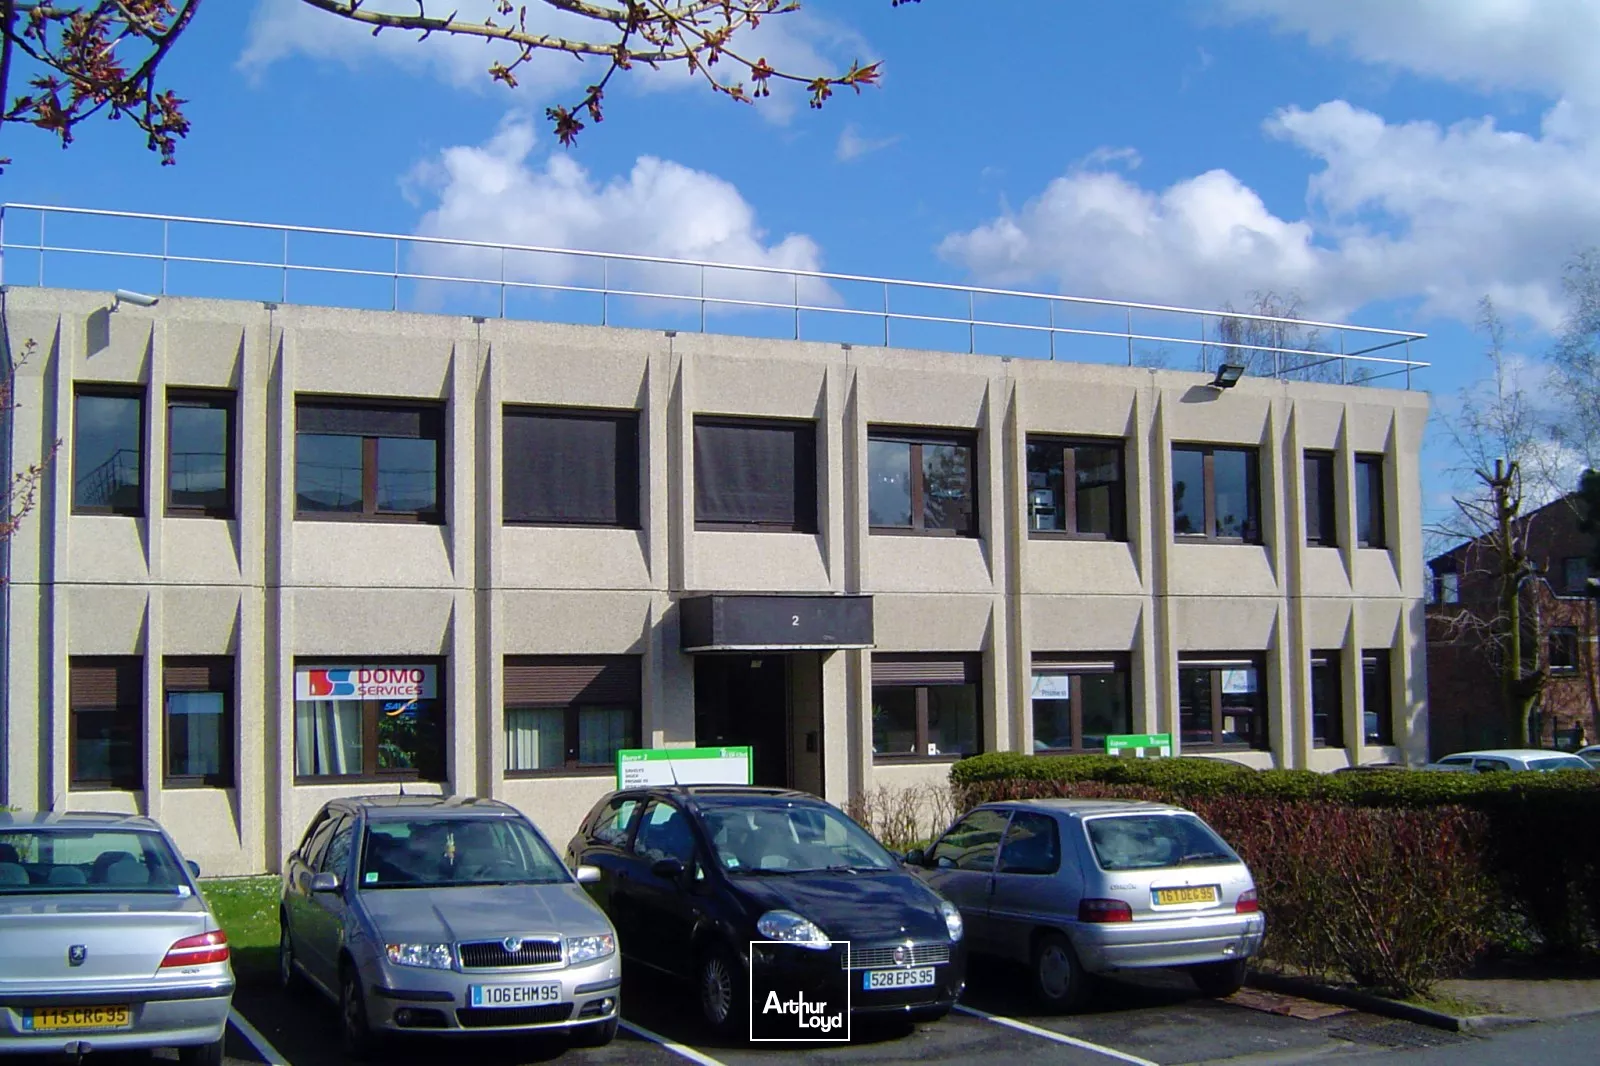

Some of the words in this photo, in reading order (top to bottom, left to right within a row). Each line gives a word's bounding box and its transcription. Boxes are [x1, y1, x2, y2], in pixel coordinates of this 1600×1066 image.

[791, 615, 800, 626] 2
[357, 668, 426, 684] DOMO
[357, 685, 424, 696] SERVICES
[871, 972, 894, 987] 528
[896, 971, 917, 986] EPS
[919, 969, 933, 984] 95
[486, 987, 511, 1004] 106
[513, 985, 539, 1002] EHM
[541, 985, 559, 1001] 95
